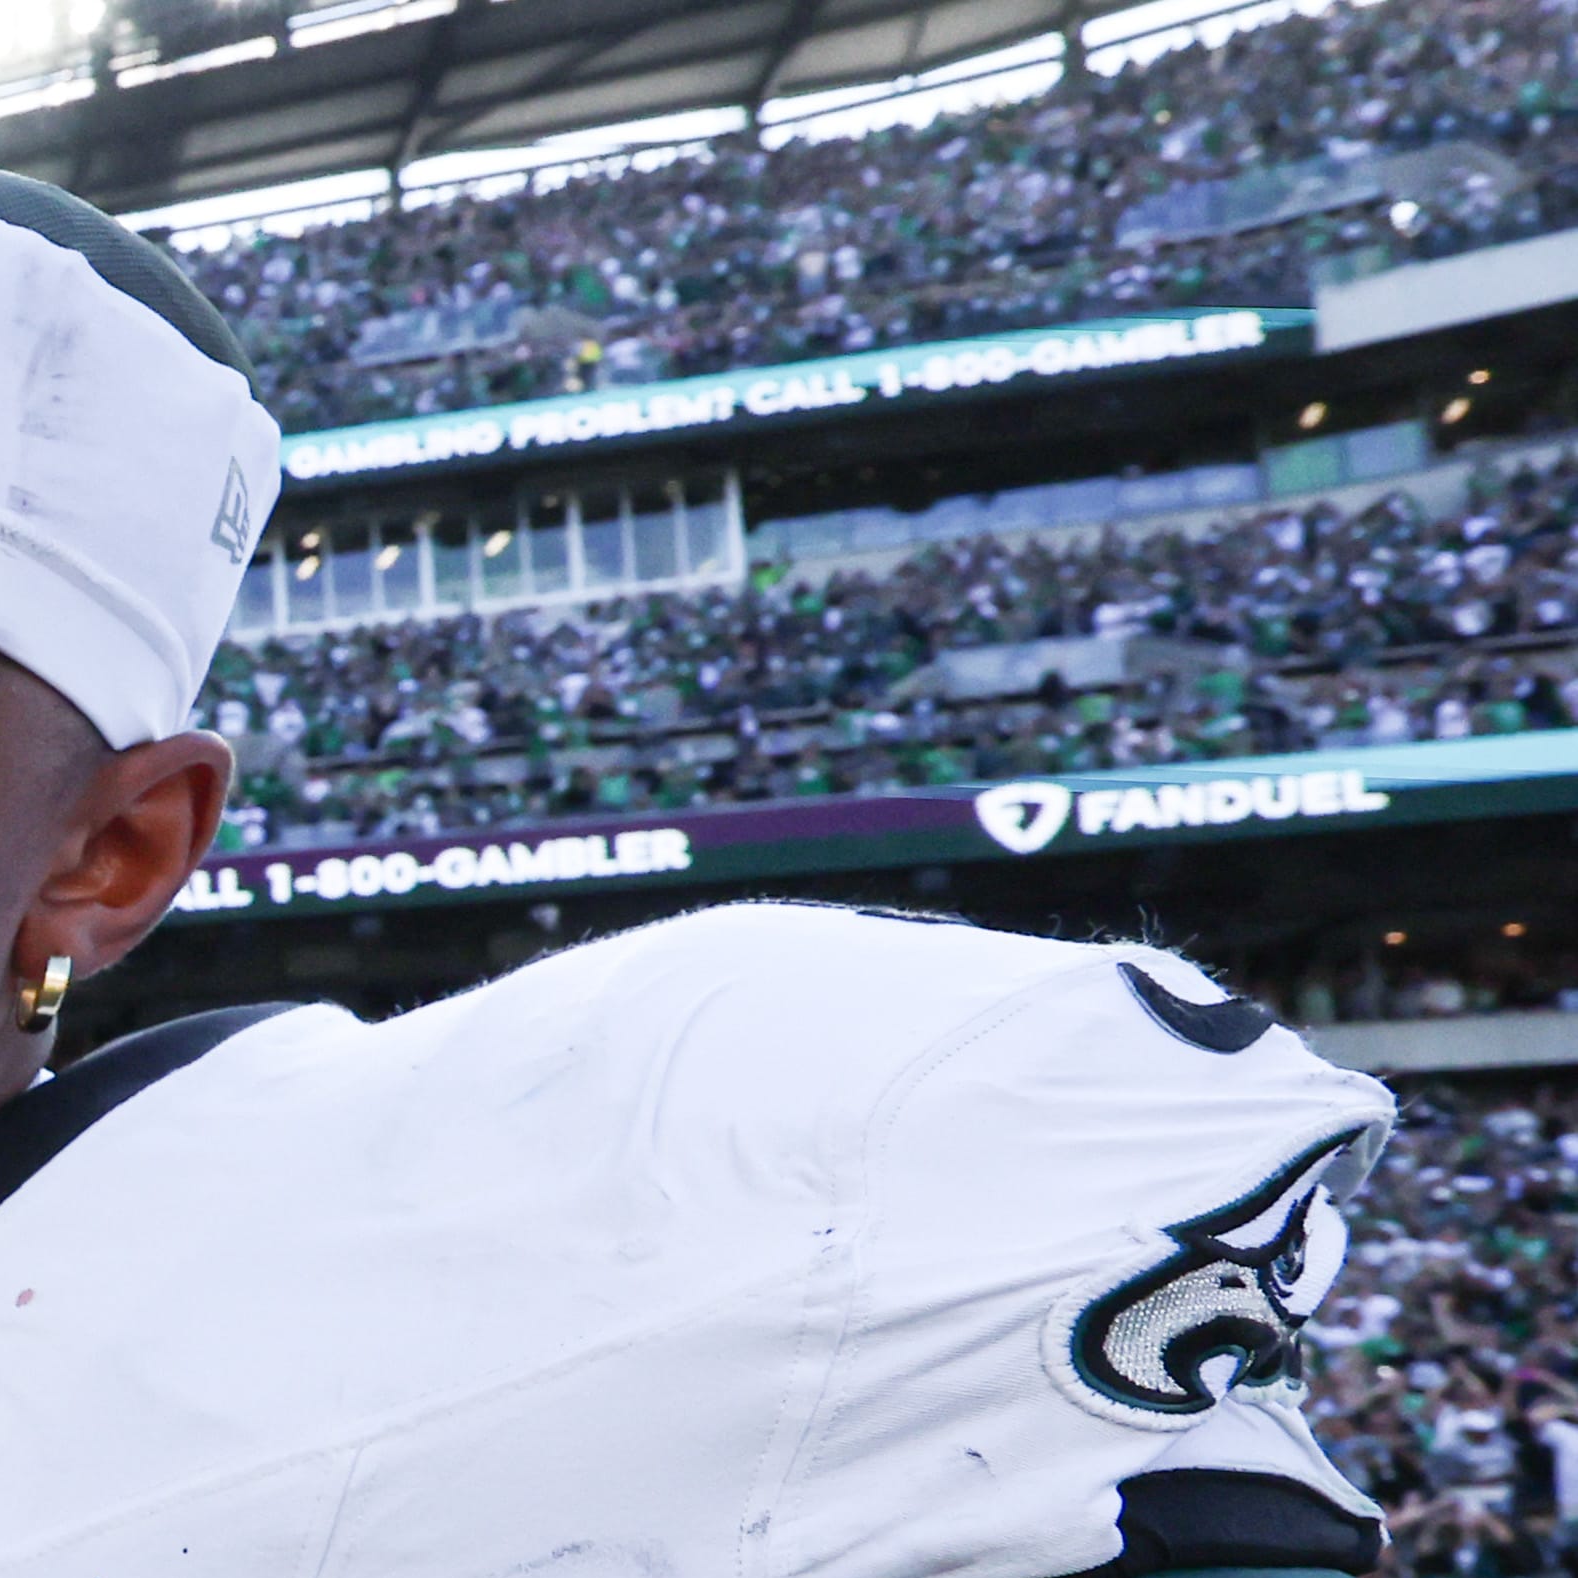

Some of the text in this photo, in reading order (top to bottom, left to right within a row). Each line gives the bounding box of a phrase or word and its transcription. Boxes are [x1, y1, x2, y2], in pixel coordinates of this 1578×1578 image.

[285, 311, 1266, 480] GAMBLING PROBLEM? CALL 1-800-GAMBLER
[1077, 769, 1390, 834] FANDUEL
[264, 828, 692, 904] 1-800-GAMBLER
